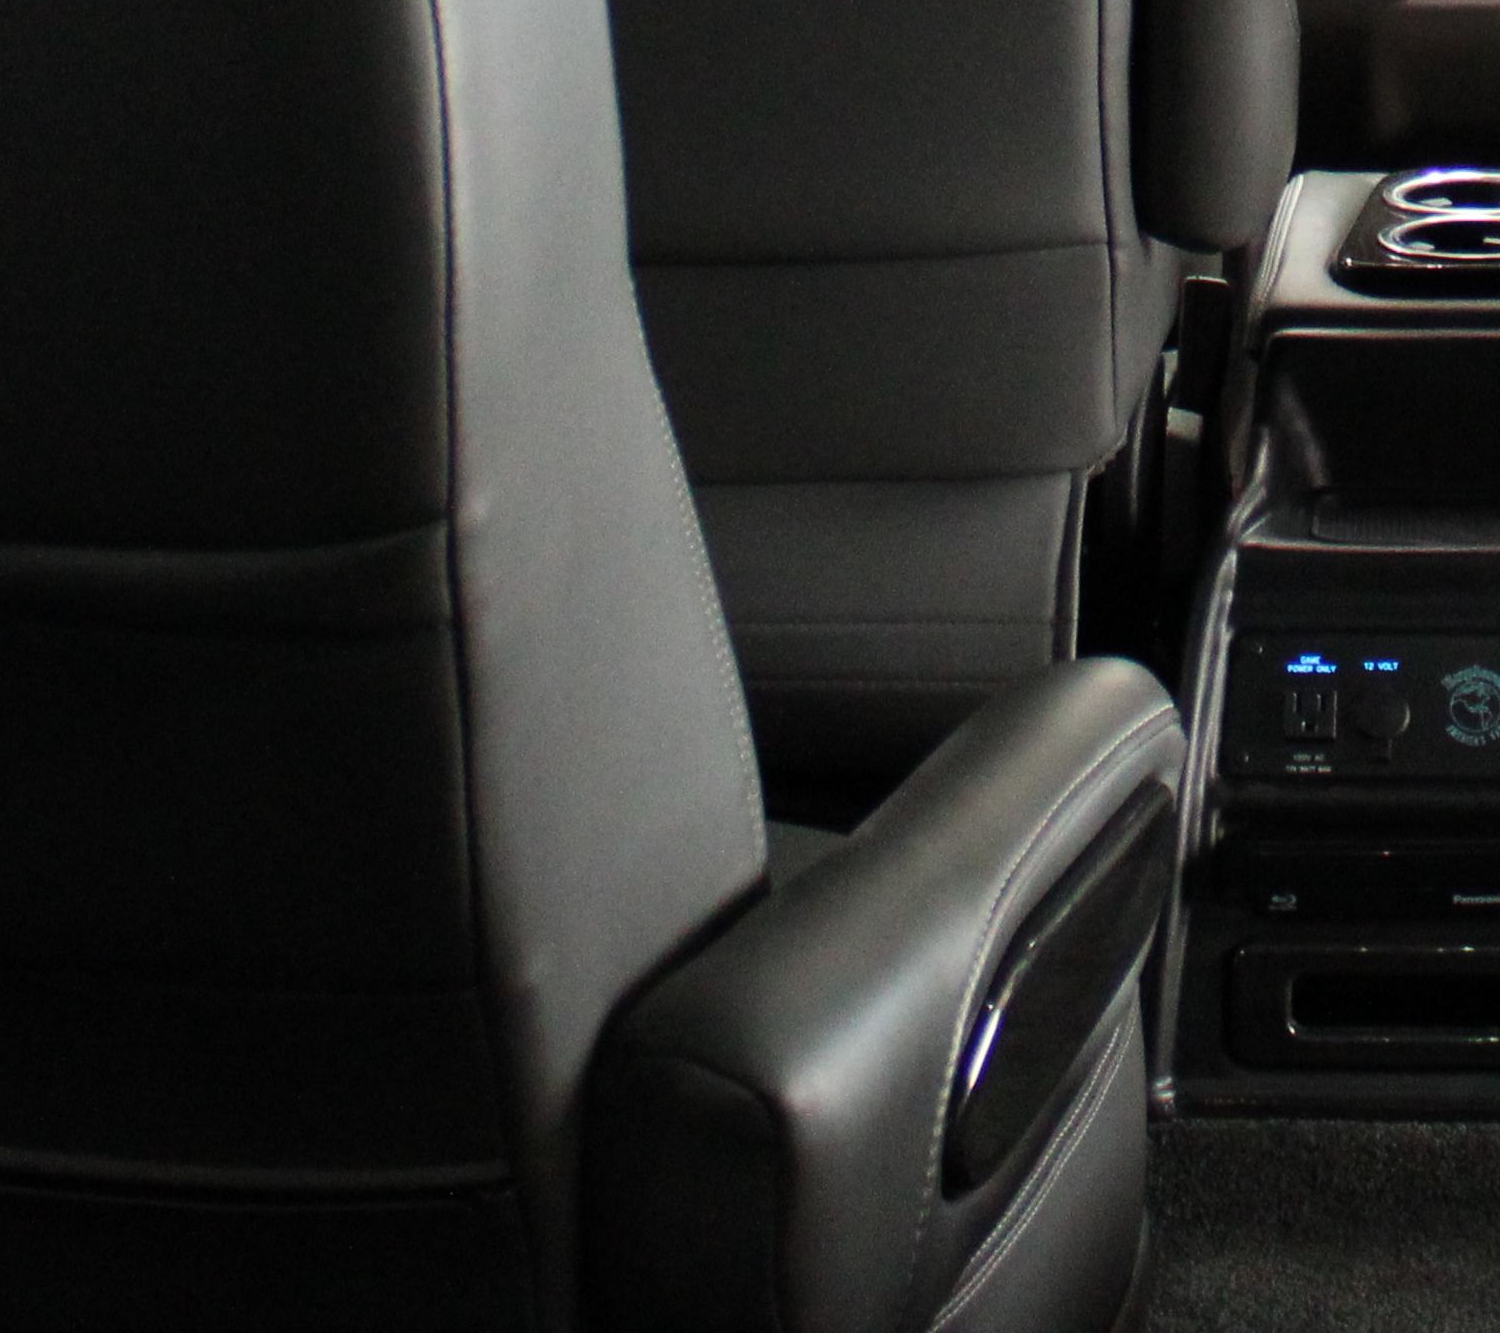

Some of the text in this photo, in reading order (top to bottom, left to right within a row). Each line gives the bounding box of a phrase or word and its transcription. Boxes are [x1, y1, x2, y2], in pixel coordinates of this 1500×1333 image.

[1287, 664, 1337, 673] POWER ONLY
[1363, 661, 1399, 671] 12 VOLT
